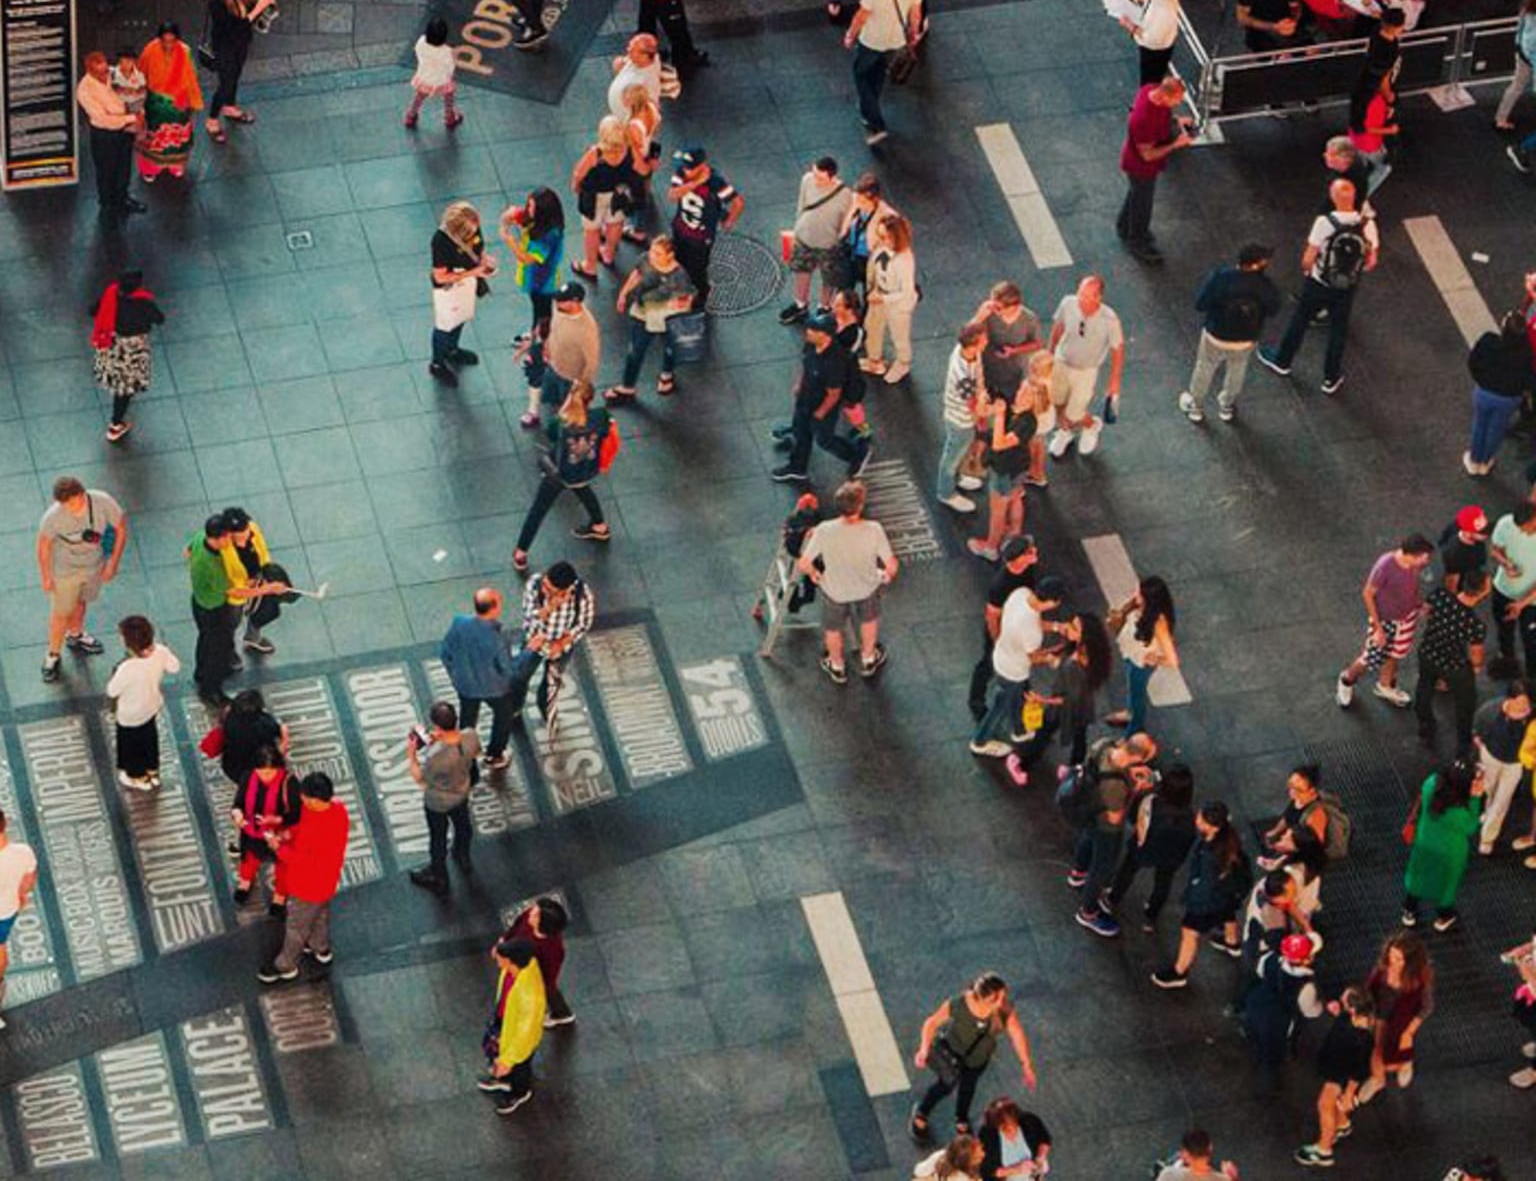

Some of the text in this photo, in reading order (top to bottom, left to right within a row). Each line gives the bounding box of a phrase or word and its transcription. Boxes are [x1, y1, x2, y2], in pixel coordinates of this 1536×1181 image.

[602, 685, 688, 777] BROADWAY
[681, 658, 751, 717] 54
[28, 719, 102, 824] IMPERIAL
[349, 666, 432, 854] AMBASSADOR
[552, 778, 612, 810] NEIL
[62, 878, 106, 977] MUSIC BOX
[93, 874, 138, 966] MARQUIS
[153, 903, 215, 948] LUNT
[18, 1075, 94, 1167] BELASCO
[101, 1044, 181, 1151] LYCEUM
[184, 1016, 269, 1136] PALACE
